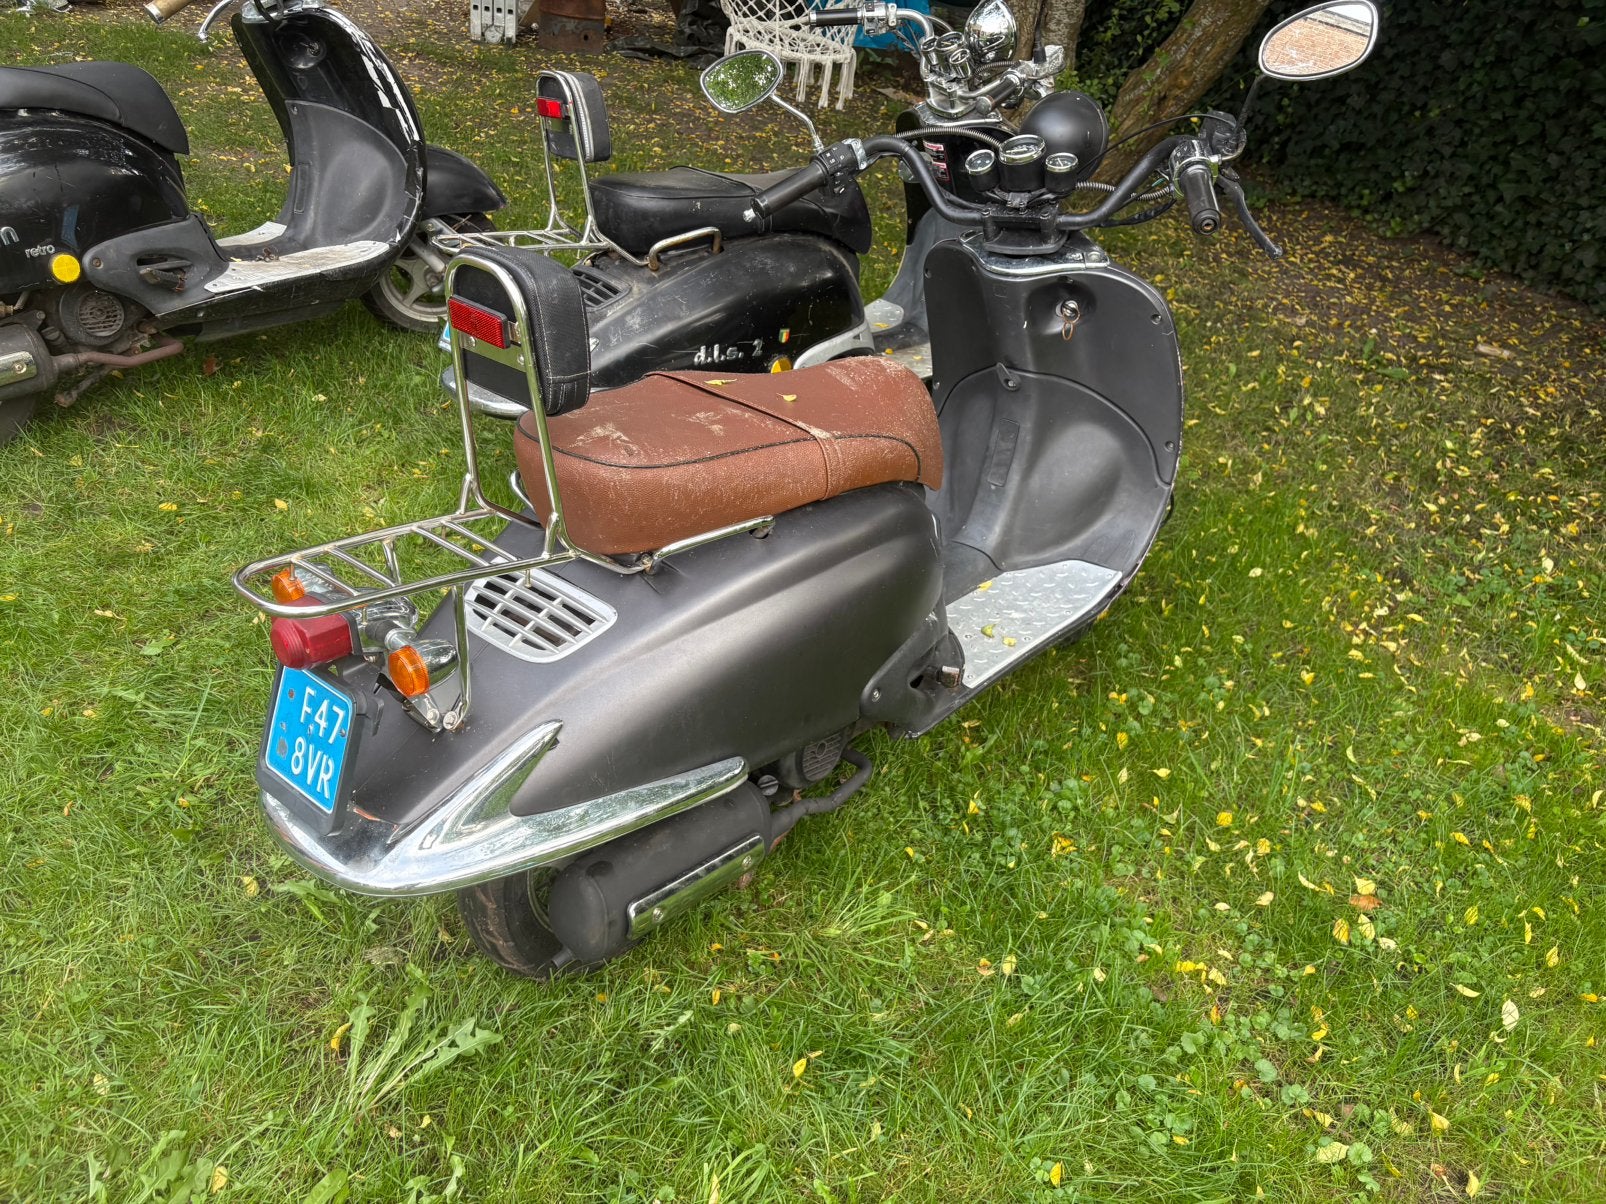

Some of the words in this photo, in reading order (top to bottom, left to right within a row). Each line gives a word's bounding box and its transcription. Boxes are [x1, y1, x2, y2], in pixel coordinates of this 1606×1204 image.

[25, 244, 56, 259] retro
[300, 686, 346, 745] F47
[290, 736, 335, 800] 8VR
